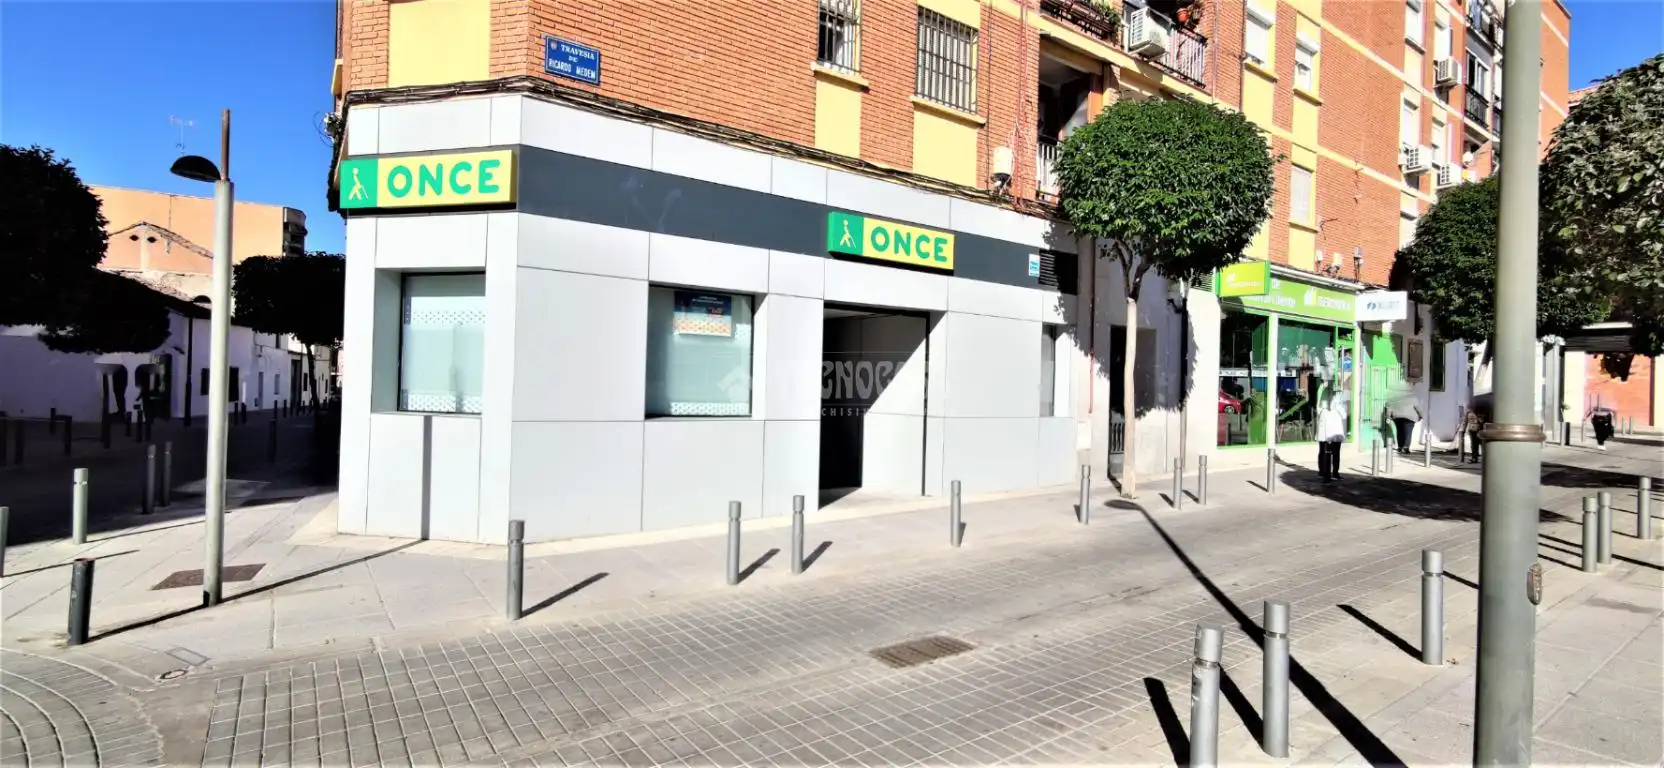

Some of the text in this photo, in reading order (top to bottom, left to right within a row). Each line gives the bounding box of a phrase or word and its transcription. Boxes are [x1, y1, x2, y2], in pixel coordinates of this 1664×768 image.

[549, 58, 572, 73] RICARDO
[387, 159, 500, 198] ONCE
[870, 226, 948, 262] ONCE
